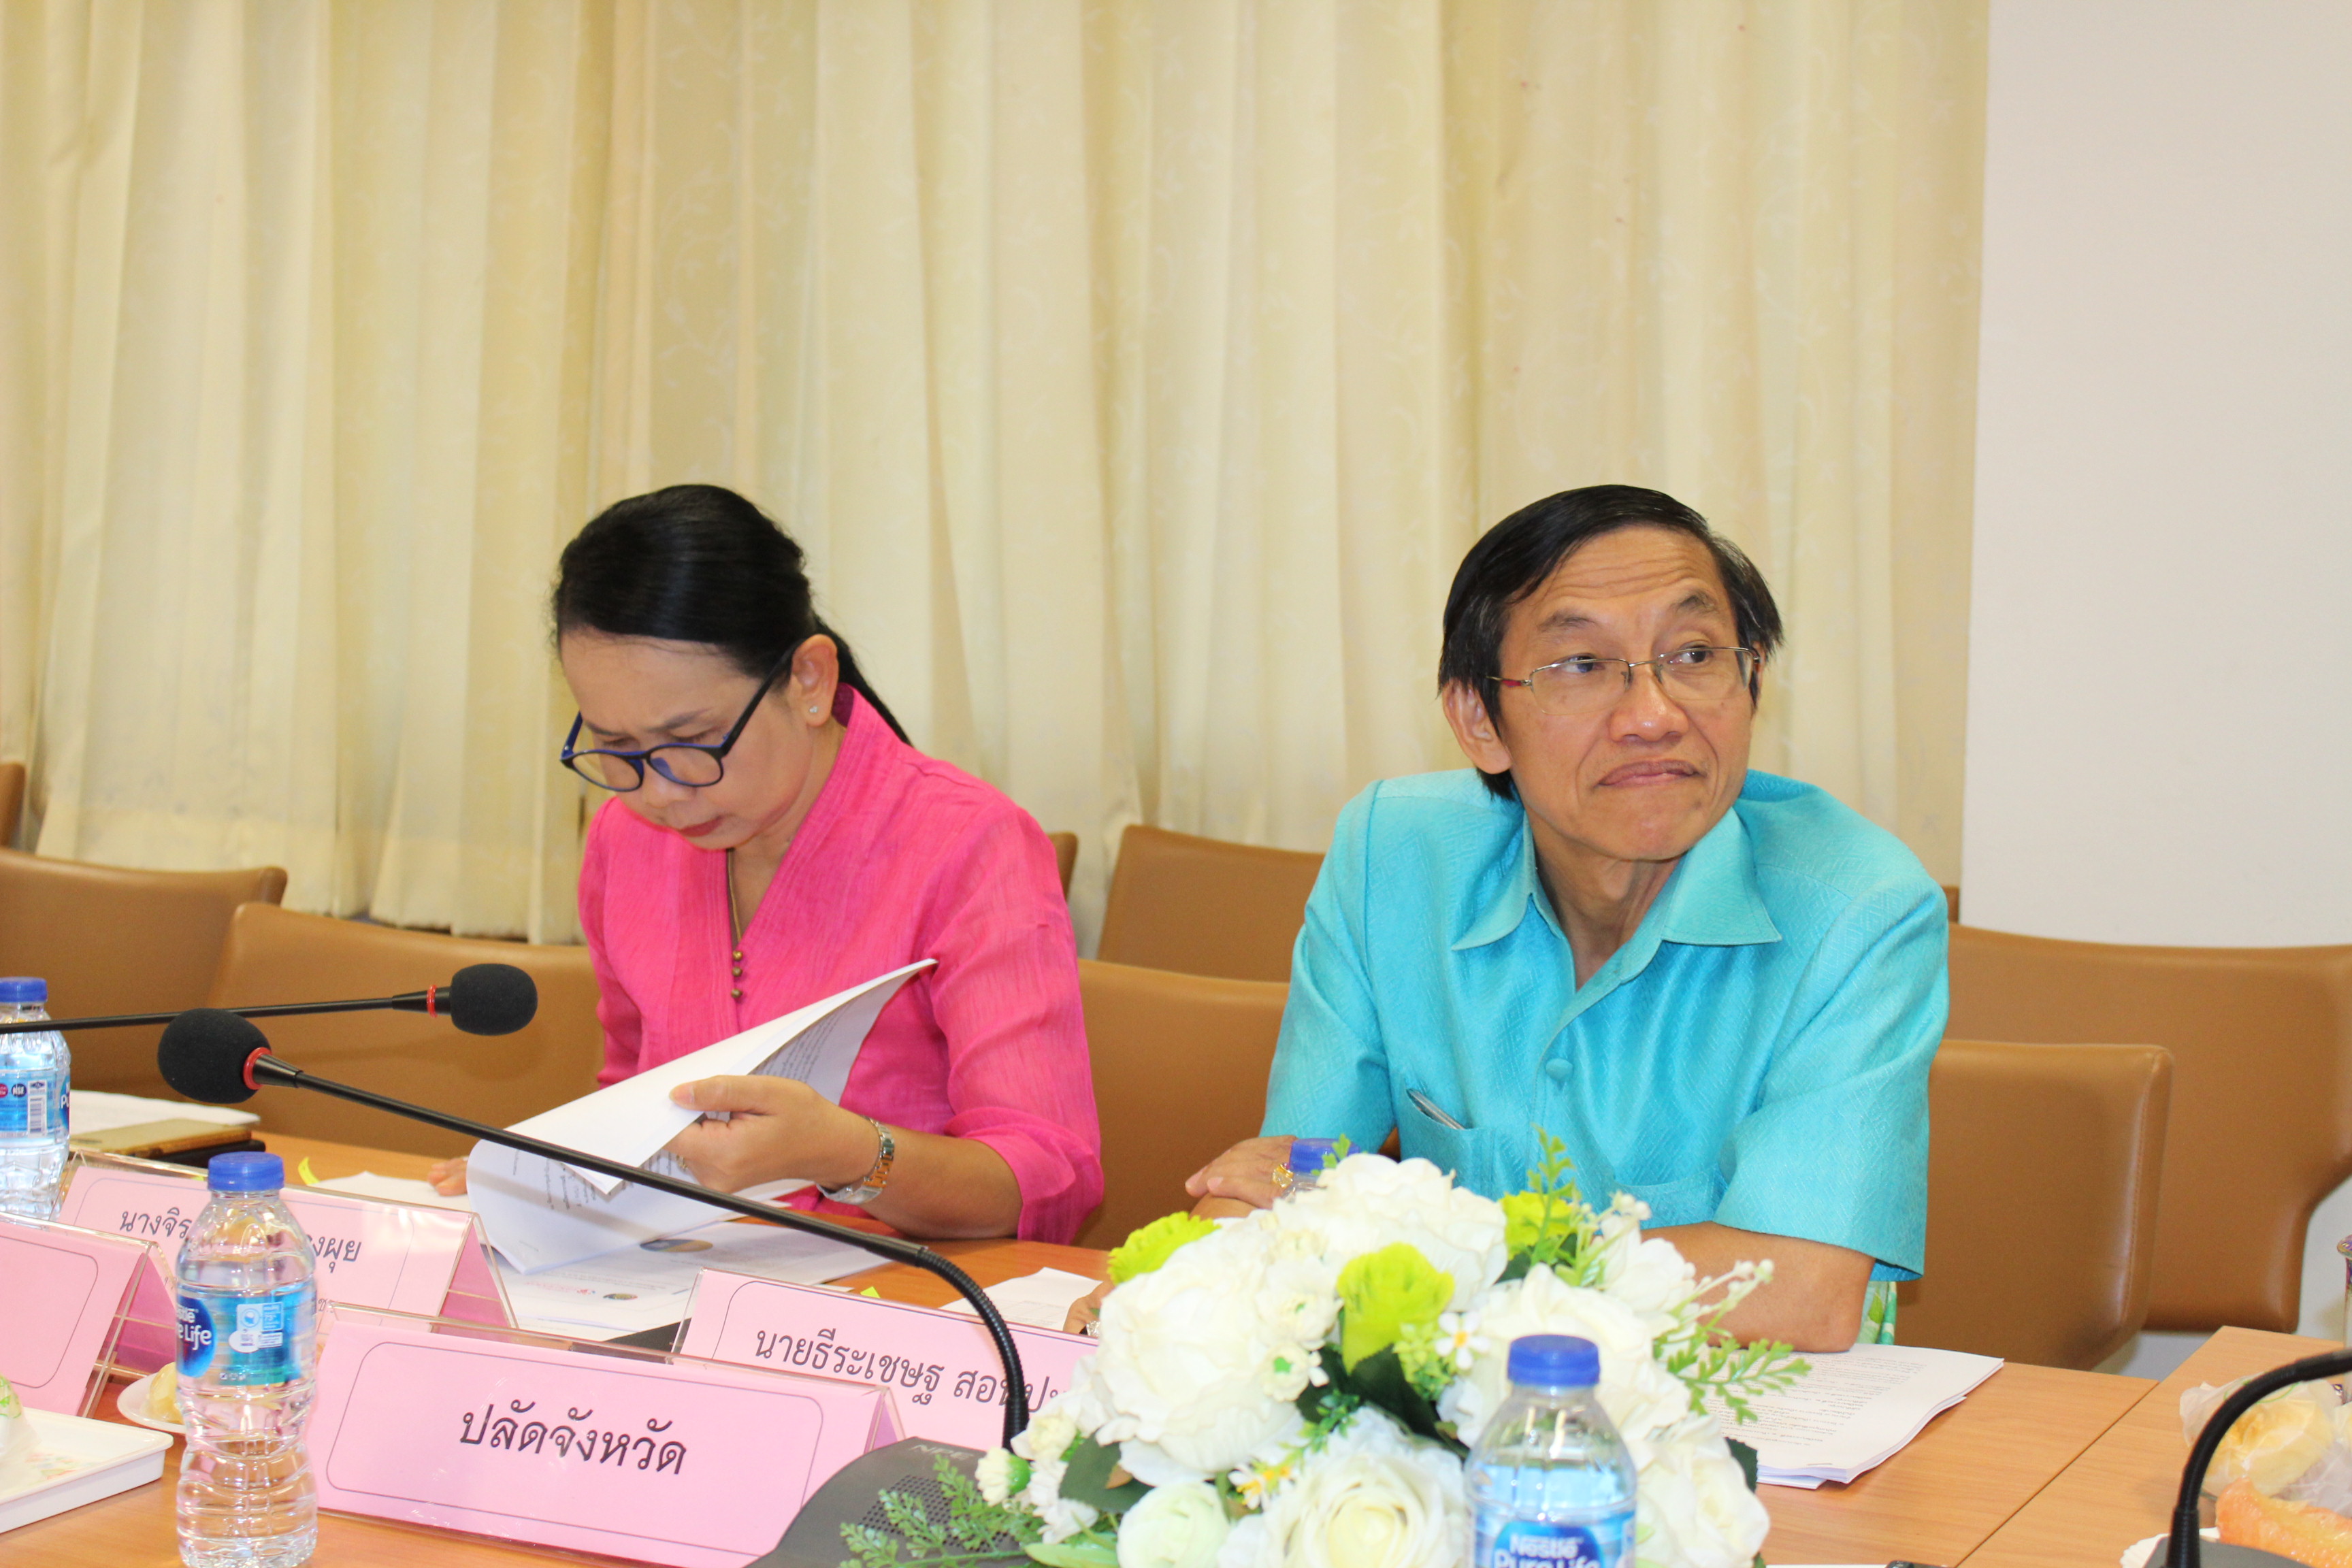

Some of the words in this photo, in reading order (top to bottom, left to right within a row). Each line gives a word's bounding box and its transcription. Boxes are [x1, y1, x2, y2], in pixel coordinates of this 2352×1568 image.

[119, 1207, 193, 1239] นางจิร
[307, 1234, 362, 1273] งผุย
[184, 1324, 212, 1351] Life
[953, 1370, 1067, 1413] สอป
[459, 1399, 687, 1475] ปลัดจังหวัด
